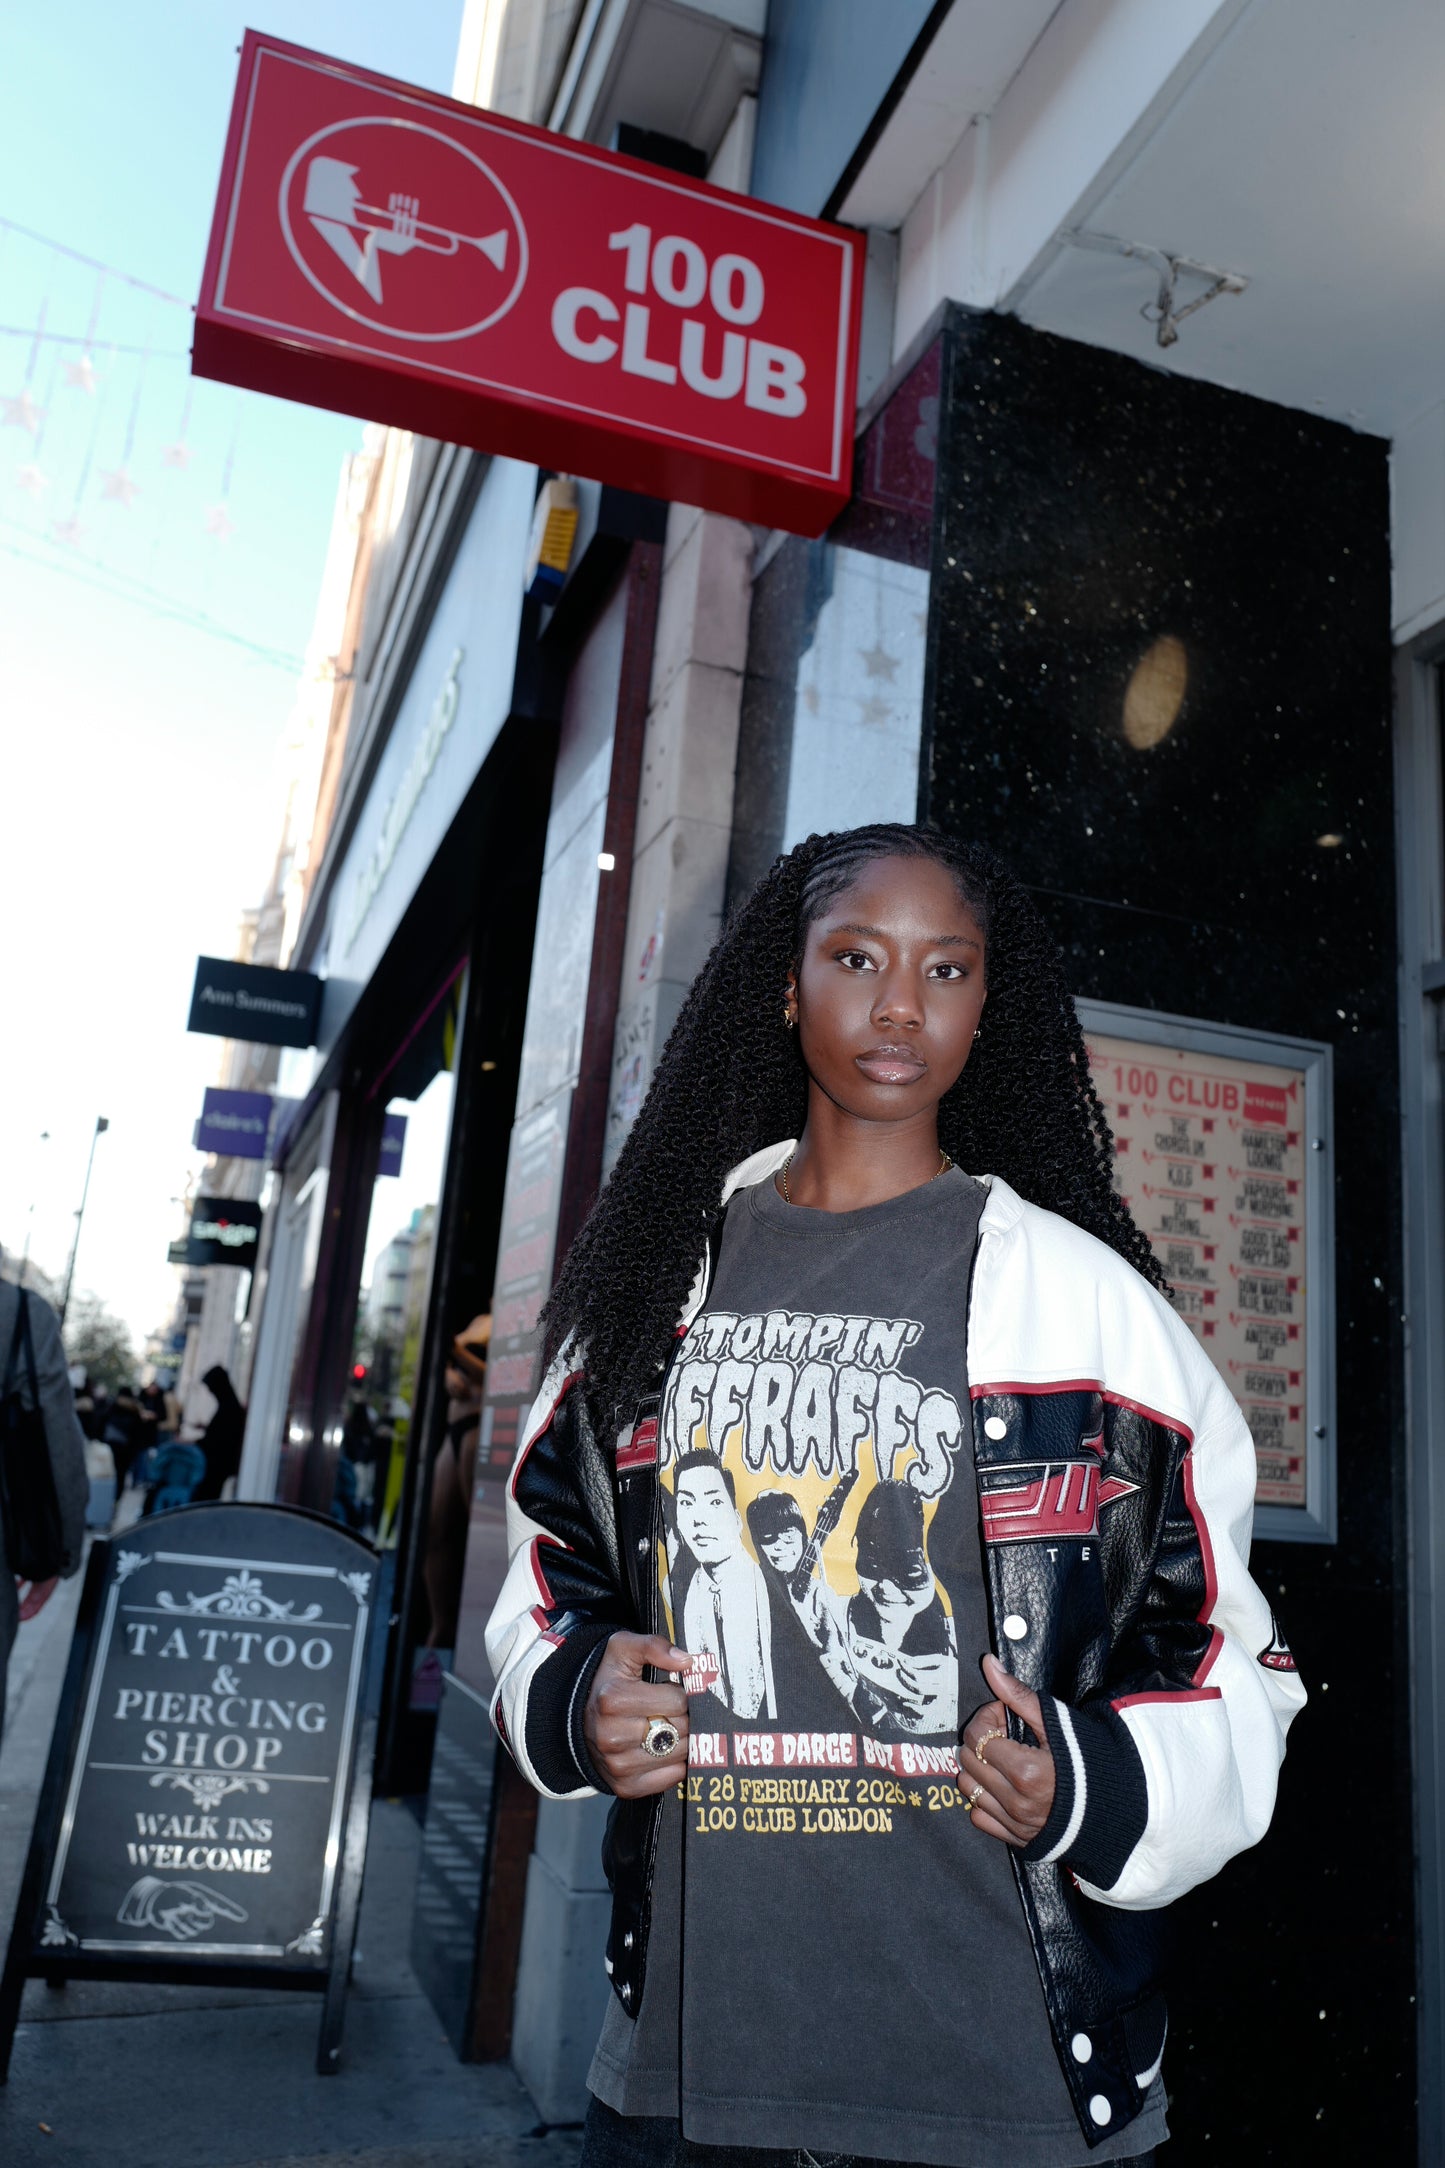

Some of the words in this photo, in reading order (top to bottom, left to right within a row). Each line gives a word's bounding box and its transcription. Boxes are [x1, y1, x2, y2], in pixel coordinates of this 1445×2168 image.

[608, 223, 765, 325] 100
[551, 286, 807, 419] CLUB
[200, 985, 234, 1009] Ann
[235, 989, 307, 1019] Summers
[1112, 1068, 1158, 1099] 100
[1168, 1075, 1240, 1112] CLUB
[125, 1622, 334, 1671] TATTOO
[211, 1663, 240, 1696] &
[112, 1688, 327, 1734] PIERCING
[141, 1728, 284, 1772] SHOP
[733, 1733, 775, 1766] KEB
[782, 1732, 853, 1765] DARGE
[863, 1735, 897, 1772] BOZ
[708, 1773, 736, 1802] 28
[740, 1778, 850, 1805] FEBRUARY
[856, 1779, 906, 1805] 2026
[135, 1811, 219, 1841] WALK
[226, 1816, 274, 1843] INS
[696, 1806, 737, 1833] 100
[743, 1806, 797, 1833] CLUB
[802, 1806, 893, 1833] LONDON
[126, 1842, 273, 1874] WELCOME
